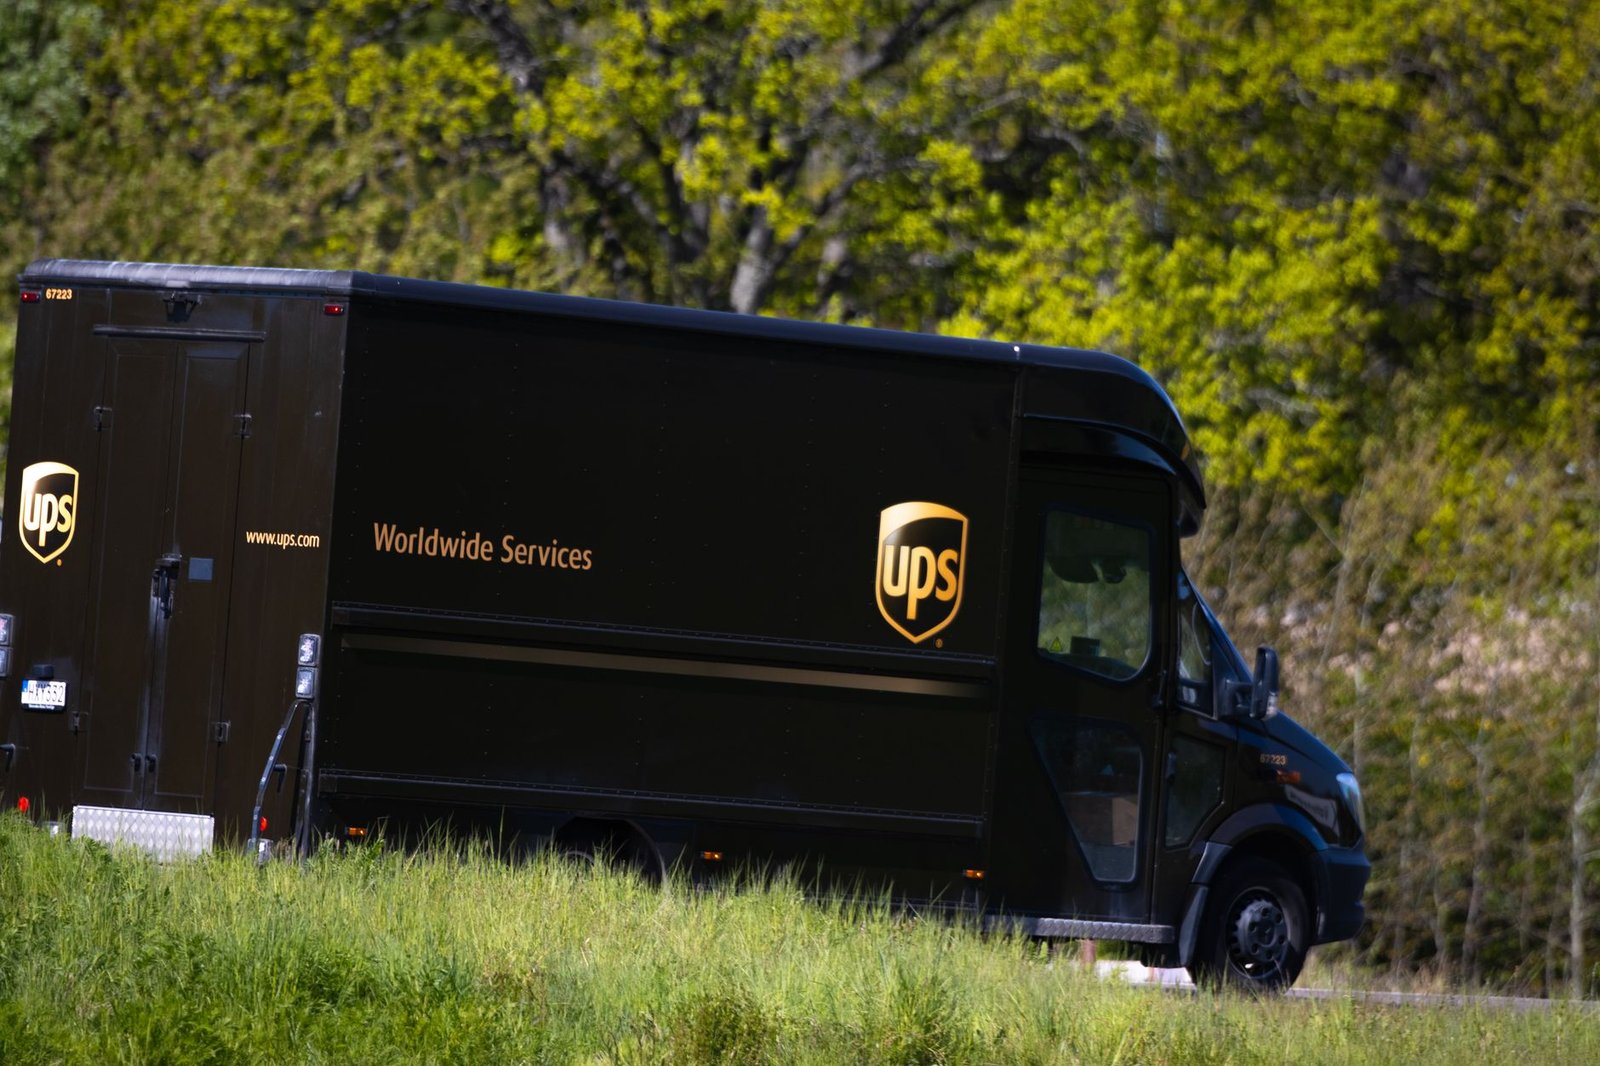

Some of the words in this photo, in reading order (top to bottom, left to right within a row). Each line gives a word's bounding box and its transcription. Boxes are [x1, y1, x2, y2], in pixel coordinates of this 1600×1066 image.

[45, 288, 73, 300] 67223
[24, 493, 73, 547] ups
[246, 531, 320, 550] www.ups.com
[373, 522, 494, 562] Worldwide
[500, 534, 593, 570] Services
[882, 544, 959, 620] ups
